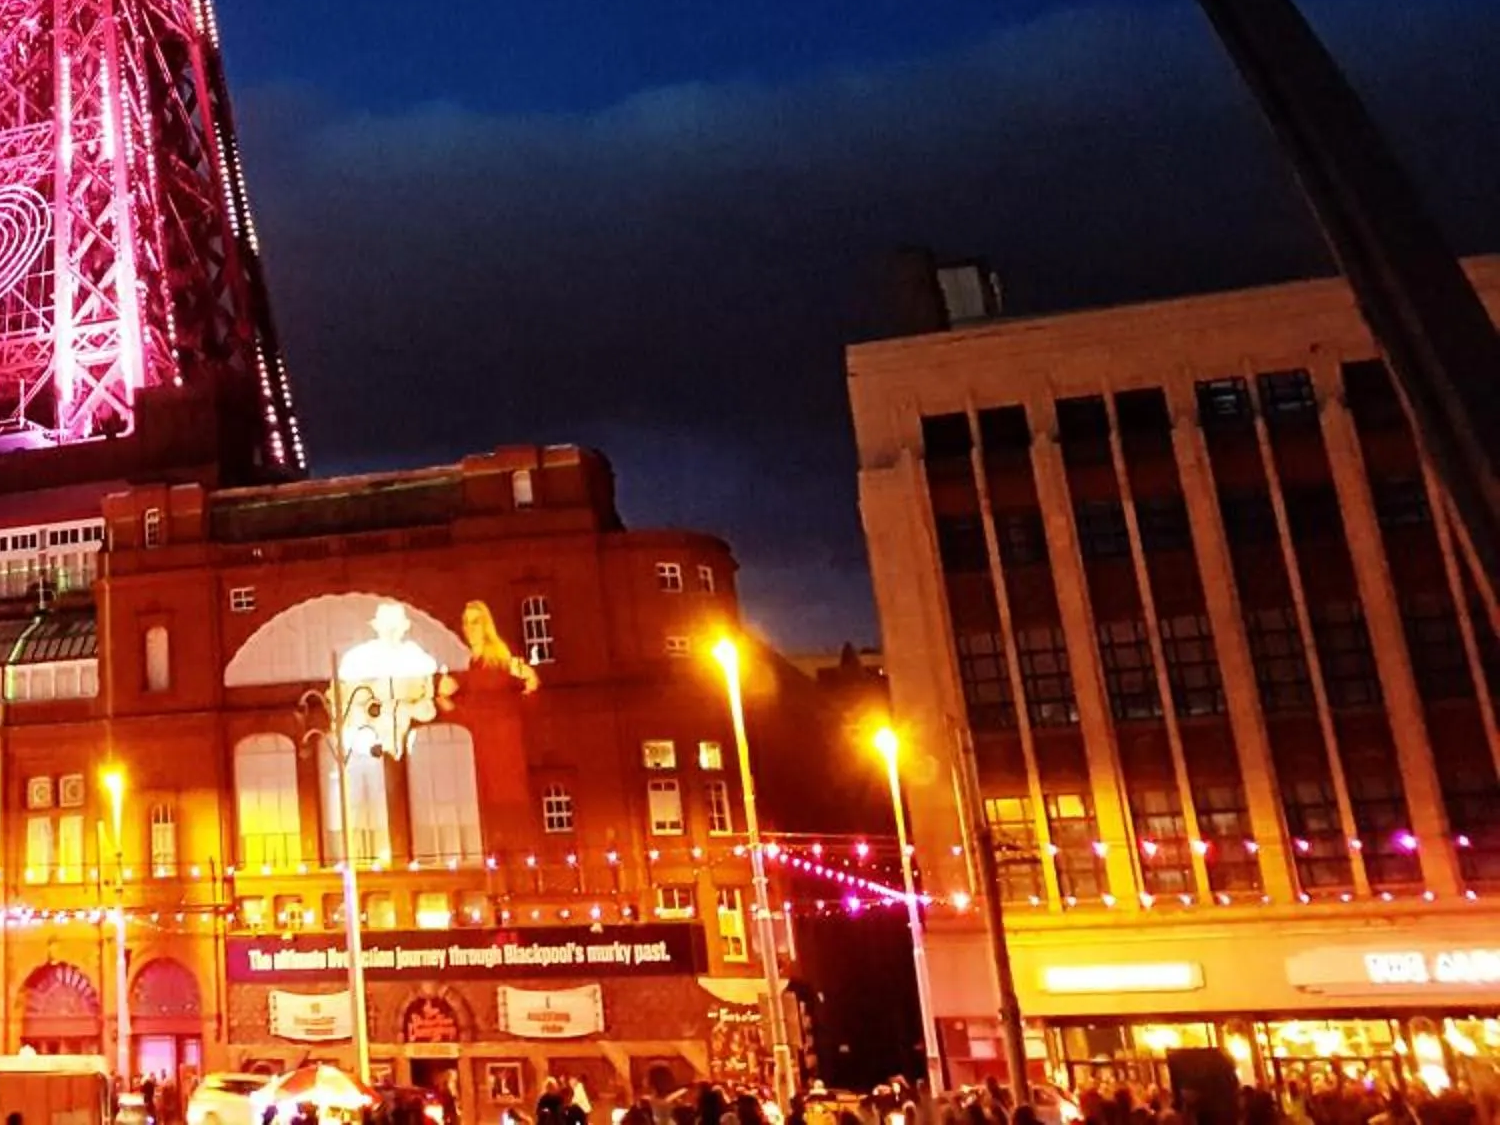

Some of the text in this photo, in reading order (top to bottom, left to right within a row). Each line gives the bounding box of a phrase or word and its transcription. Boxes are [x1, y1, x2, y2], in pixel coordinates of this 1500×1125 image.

[248, 949, 272, 971] The
[355, 946, 395, 968] ction
[396, 946, 445, 970] journey
[448, 944, 502, 968] through
[503, 942, 584, 967] Blackpool's
[586, 941, 631, 966] murky
[633, 940, 671, 965] past.
